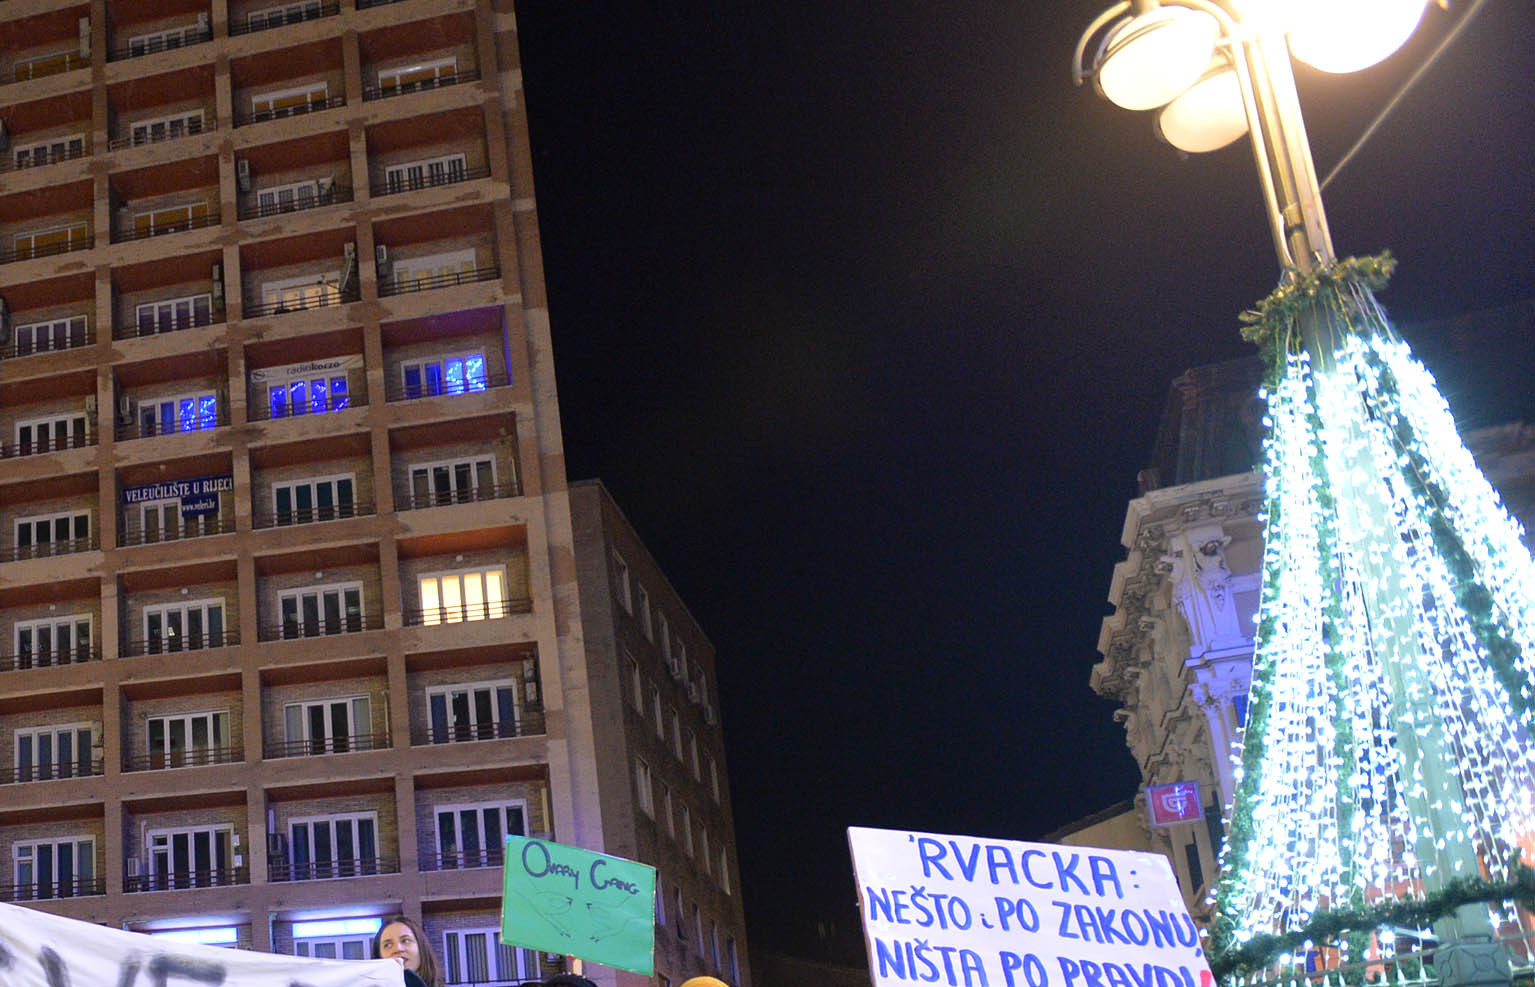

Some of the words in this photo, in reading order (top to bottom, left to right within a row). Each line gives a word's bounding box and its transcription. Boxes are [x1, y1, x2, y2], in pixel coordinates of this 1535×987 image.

[126, 482, 190, 502] VELEUČILIŠTE
[193, 482, 200, 494] U
[202, 477, 233, 493] RIJECI
[866, 885, 973, 931] NEŠTO
[995, 896, 1040, 933] PO
